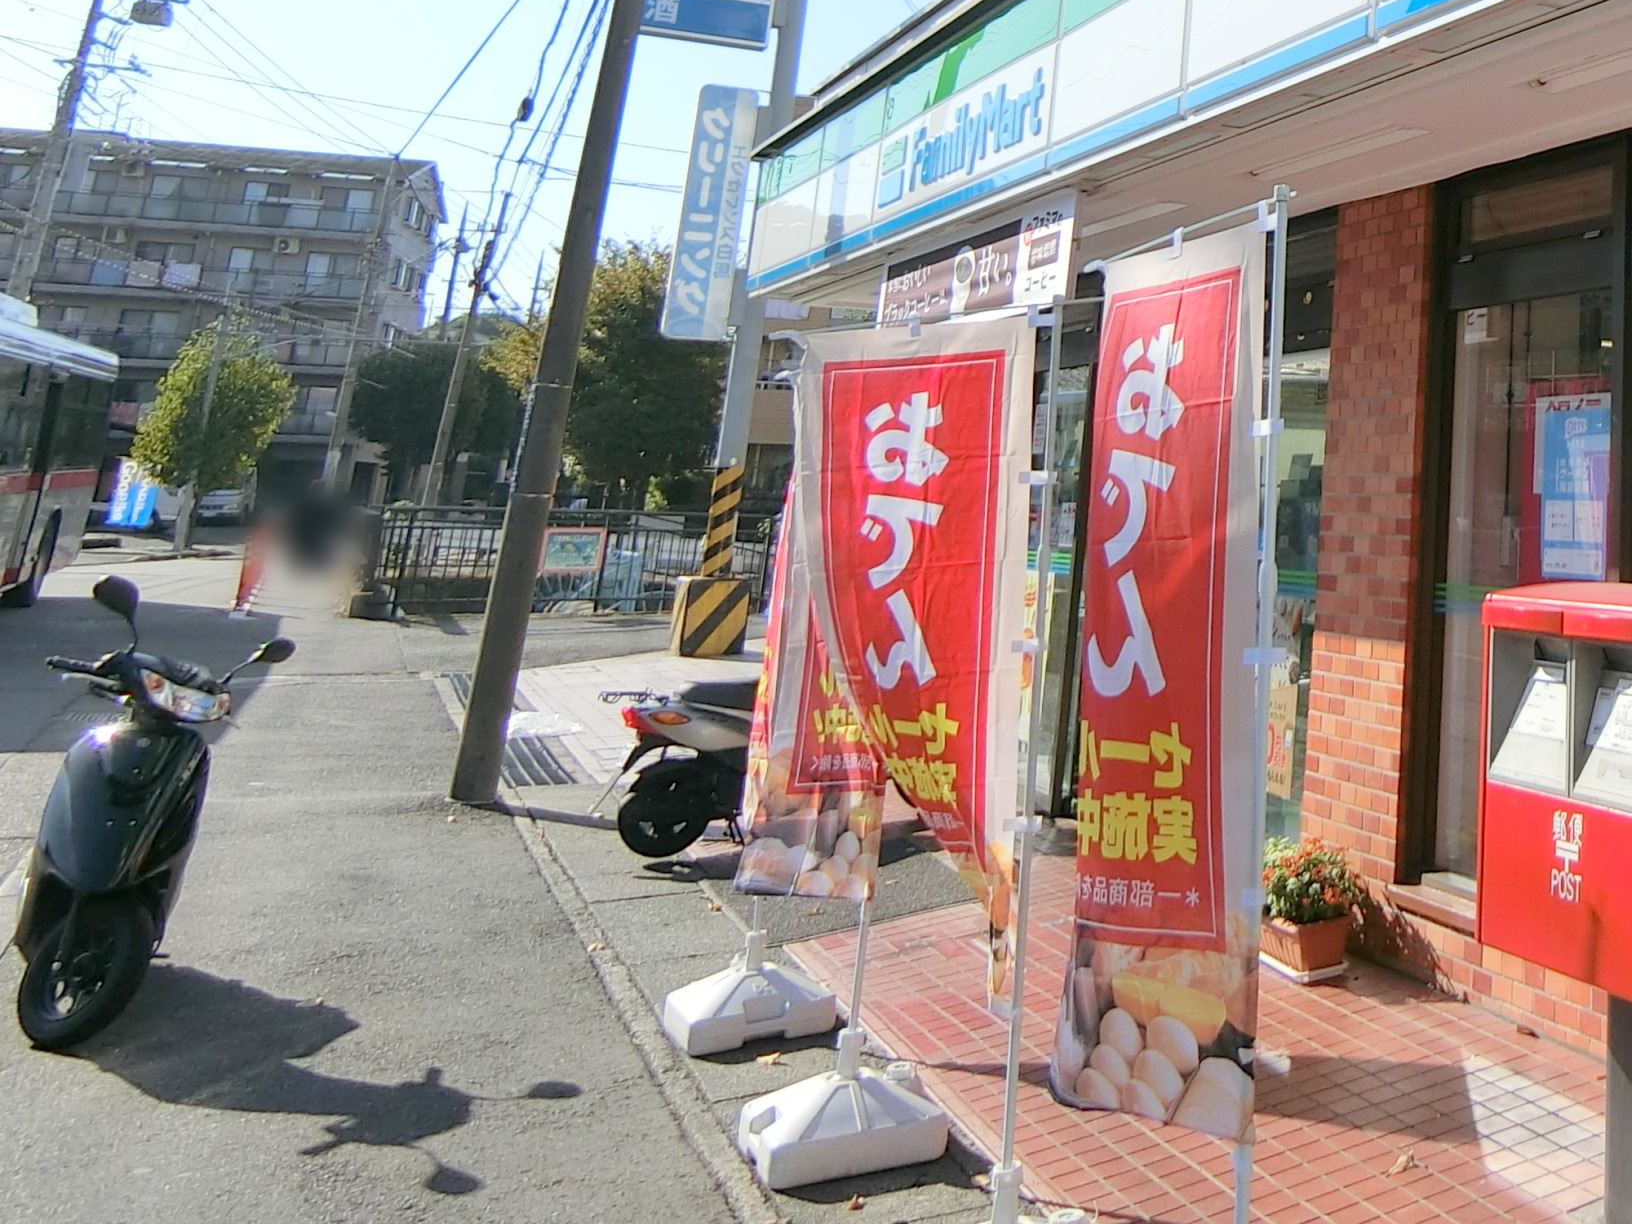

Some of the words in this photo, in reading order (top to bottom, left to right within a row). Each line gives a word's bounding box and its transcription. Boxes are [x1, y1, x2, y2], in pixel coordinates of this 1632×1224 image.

[909, 67, 1045, 192] FamilyMart
[1553, 809, 1583, 848] 郵便
[1550, 867, 1582, 903] POST
